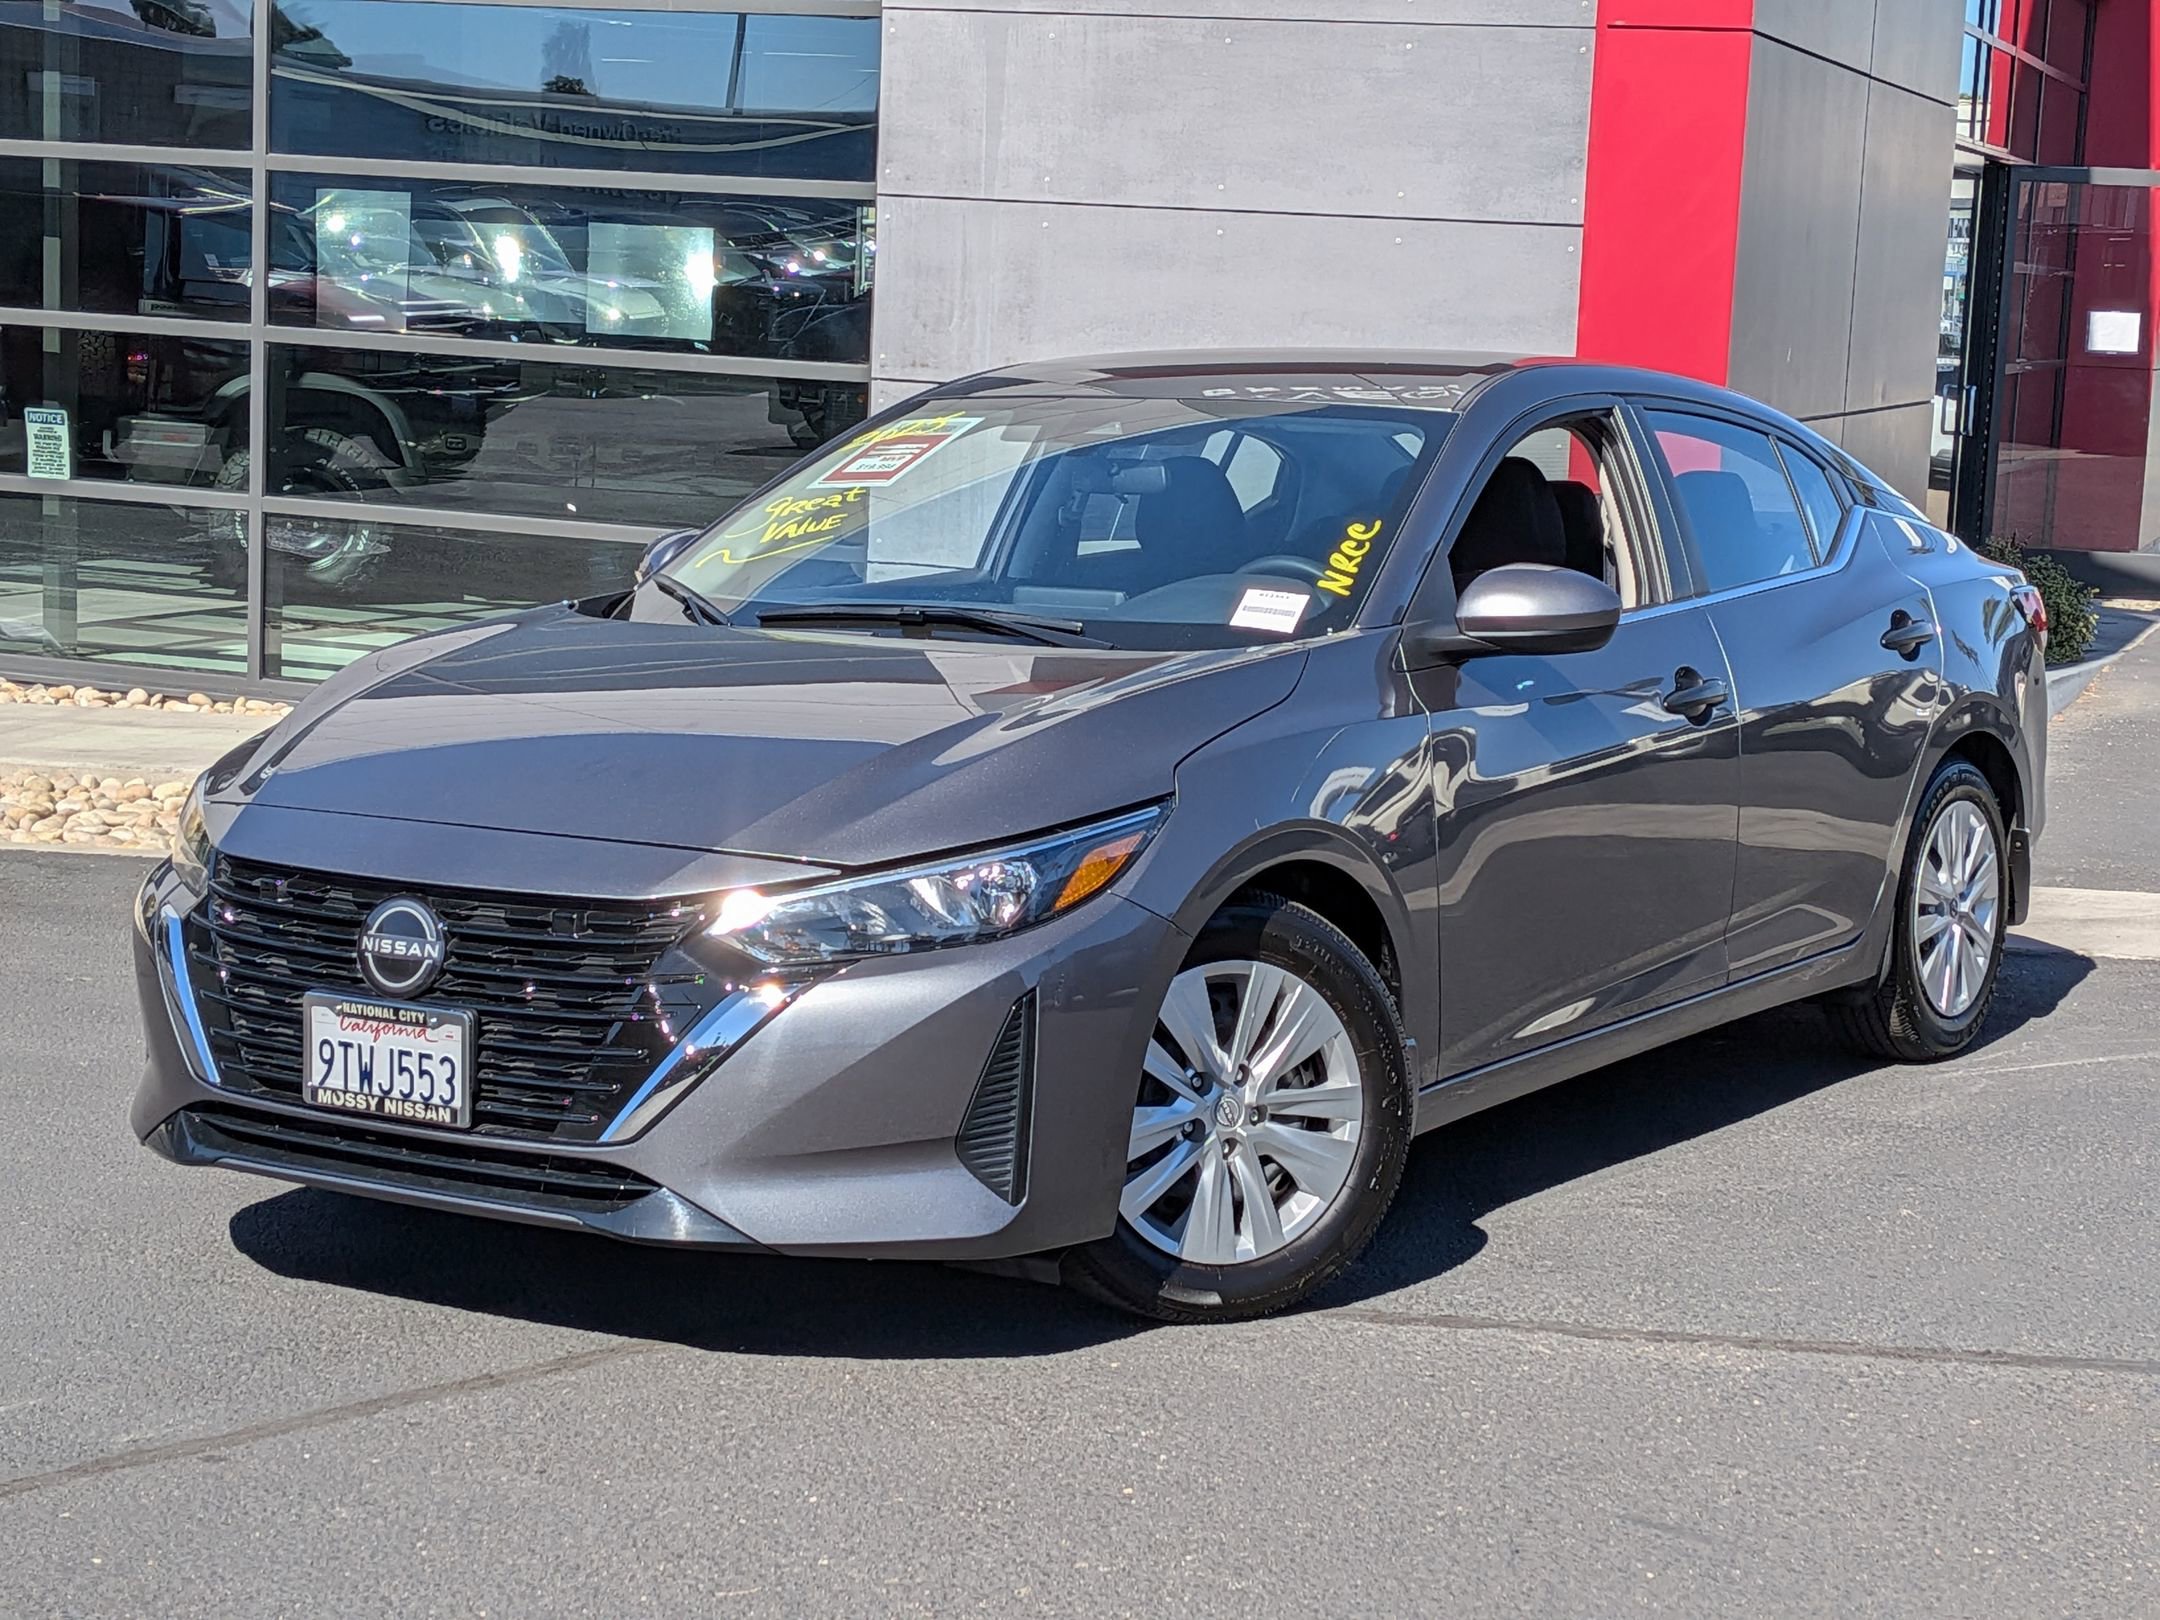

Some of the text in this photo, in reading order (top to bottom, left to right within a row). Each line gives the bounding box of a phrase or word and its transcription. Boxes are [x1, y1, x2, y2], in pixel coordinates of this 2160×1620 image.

[28, 412, 63, 424] NOTICE
[1317, 519, 1382, 597] NRCC
[361, 936, 440, 958] NISSAN
[342, 1002, 425, 1024] NATIONAL CITY
[339, 1015, 438, 1043] California
[318, 1038, 456, 1105] 9TWJ553
[317, 1088, 450, 1123] MOSSY NISSAN
